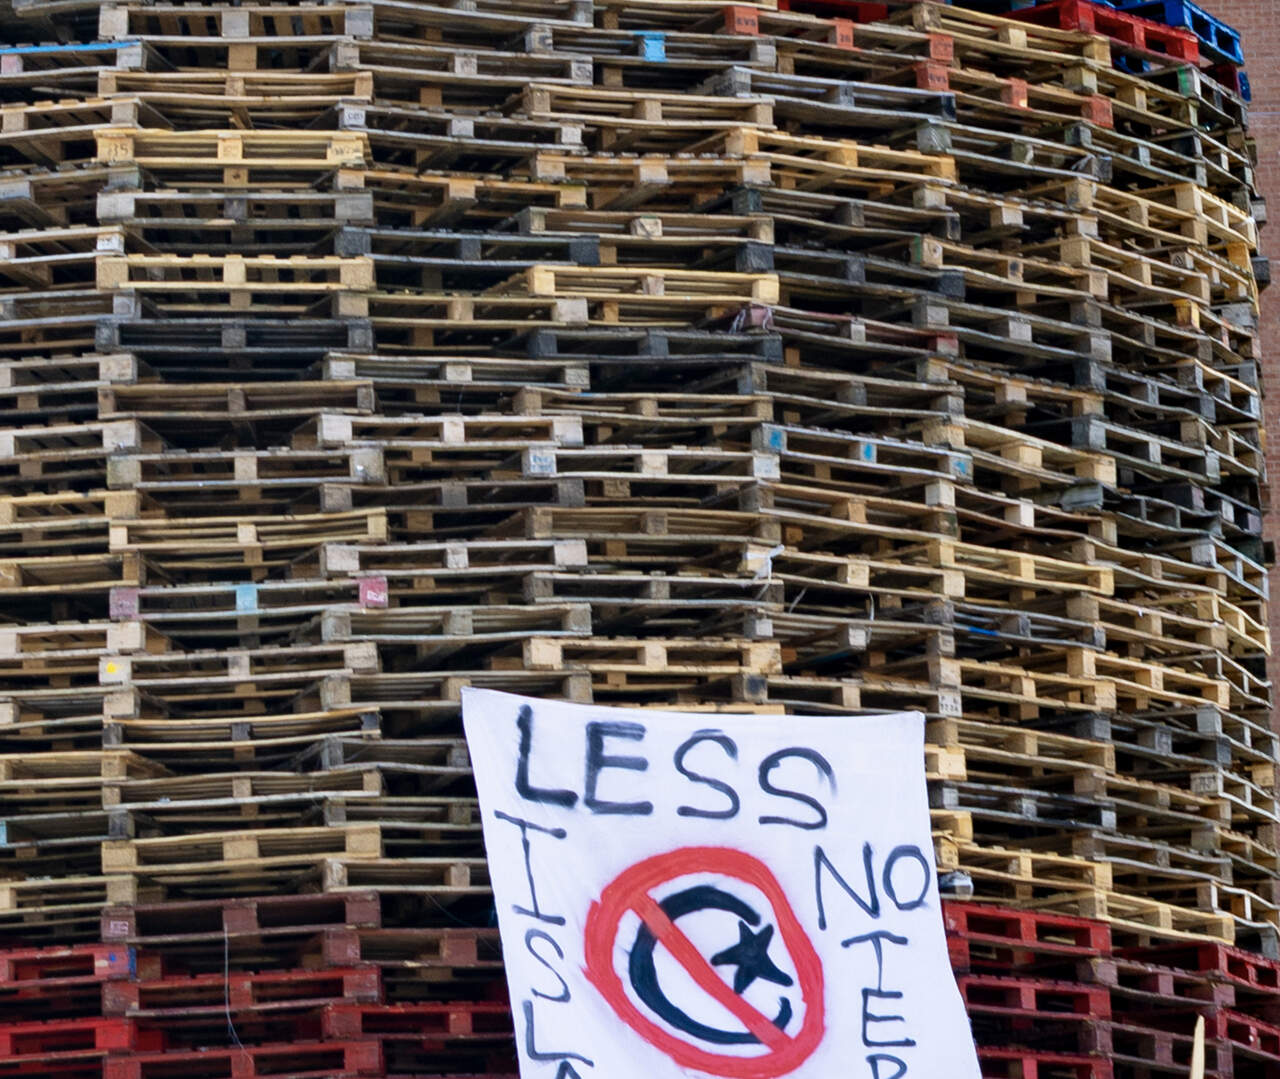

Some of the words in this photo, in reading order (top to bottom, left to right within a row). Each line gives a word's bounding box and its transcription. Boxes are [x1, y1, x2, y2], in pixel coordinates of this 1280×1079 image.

[515, 704, 837, 830] LESS
[494, 809, 594, 1079] ISL
[814, 841, 931, 930] NO
